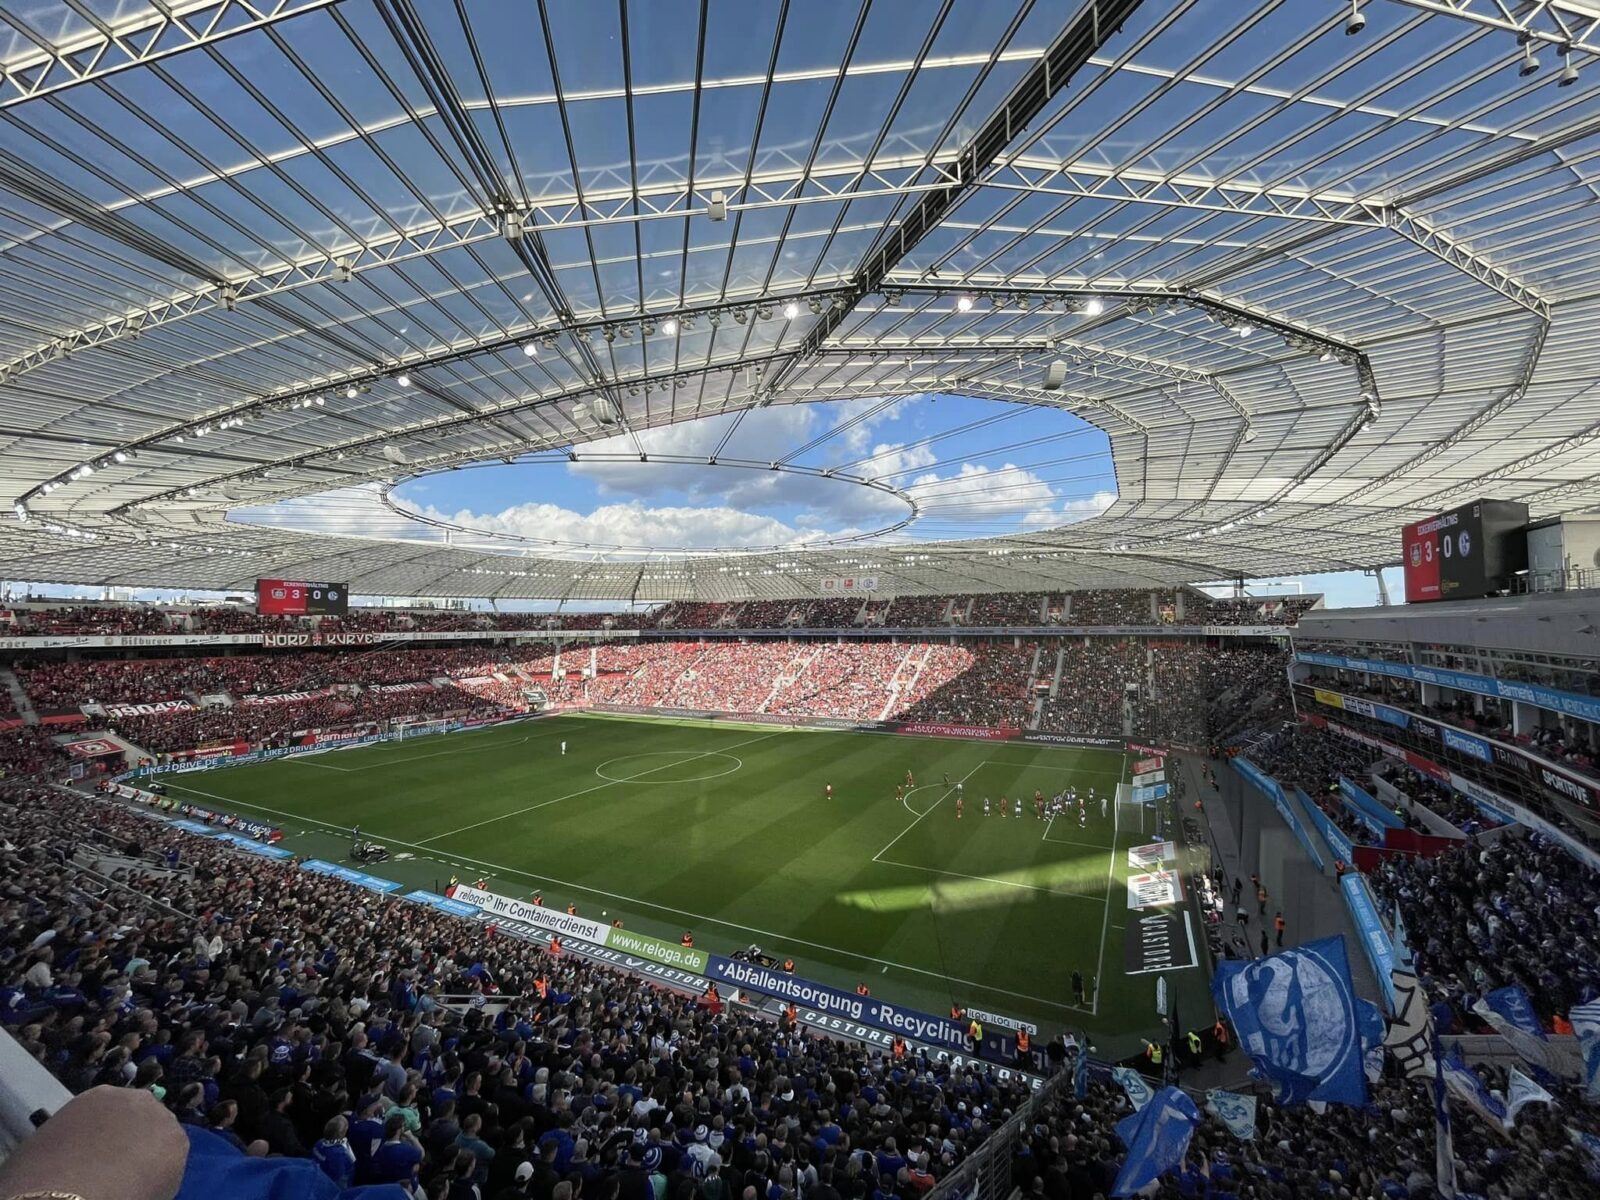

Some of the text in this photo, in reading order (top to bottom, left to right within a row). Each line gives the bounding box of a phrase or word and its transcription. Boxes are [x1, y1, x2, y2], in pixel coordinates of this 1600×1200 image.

[1425, 540, 1433, 562] 3
[1443, 535, 1452, 558] 0
[291, 590, 300, 599] 3
[312, 590, 321, 600] 0
[265, 633, 309, 647] NORD
[326, 633, 374, 645] KURVE
[493, 897, 508, 912] Ihr
[509, 902, 598, 938] Containerdienst
[562, 938, 622, 961] CASTORE
[612, 933, 701, 968] www.reloga.de
[723, 962, 863, 1019] Abfallentsorgung
[804, 1011, 894, 1046] CASTORE
